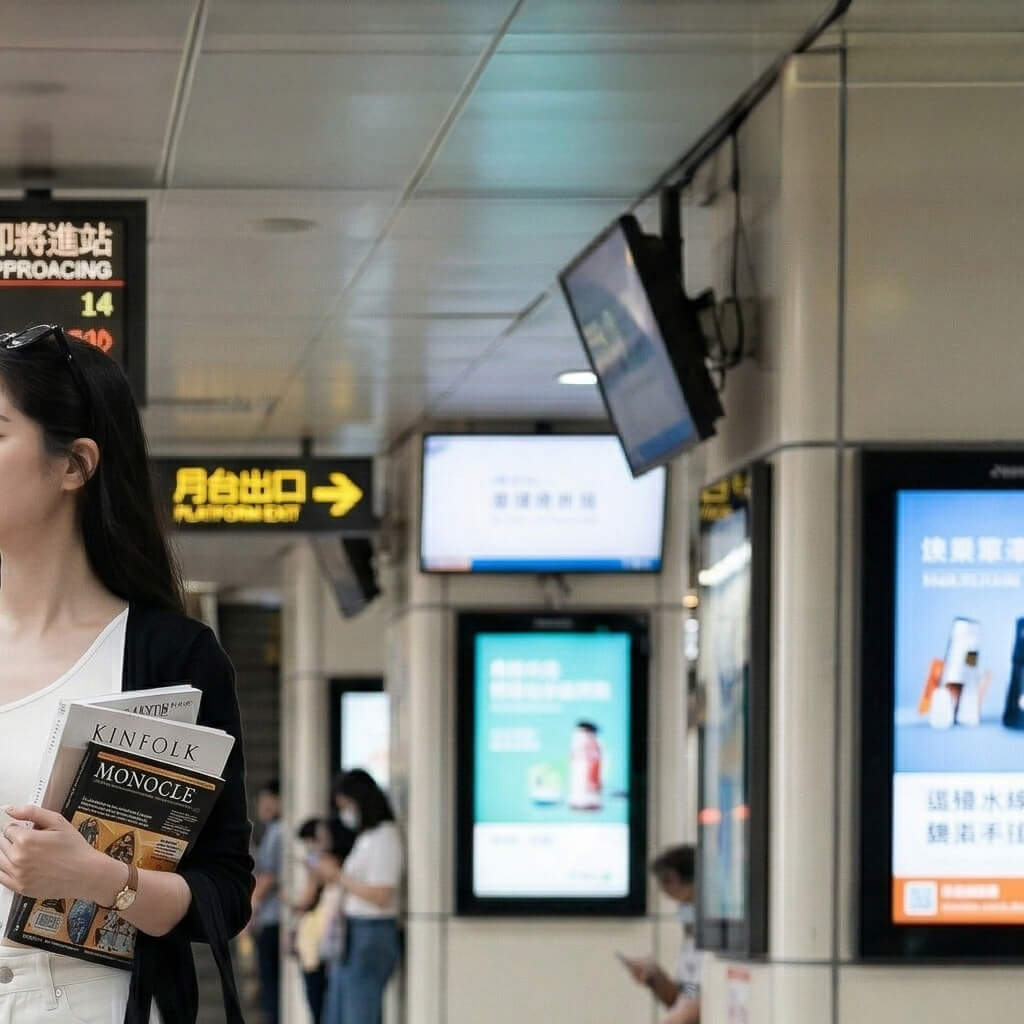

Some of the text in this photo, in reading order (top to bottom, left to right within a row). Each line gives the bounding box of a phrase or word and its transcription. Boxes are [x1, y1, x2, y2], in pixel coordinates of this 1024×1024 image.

[80, 291, 114, 318] 14
[173, 467, 307, 504] 月台出口
[92, 723, 199, 762] KINFOLK
[94, 762, 197, 804] MONOCLE
